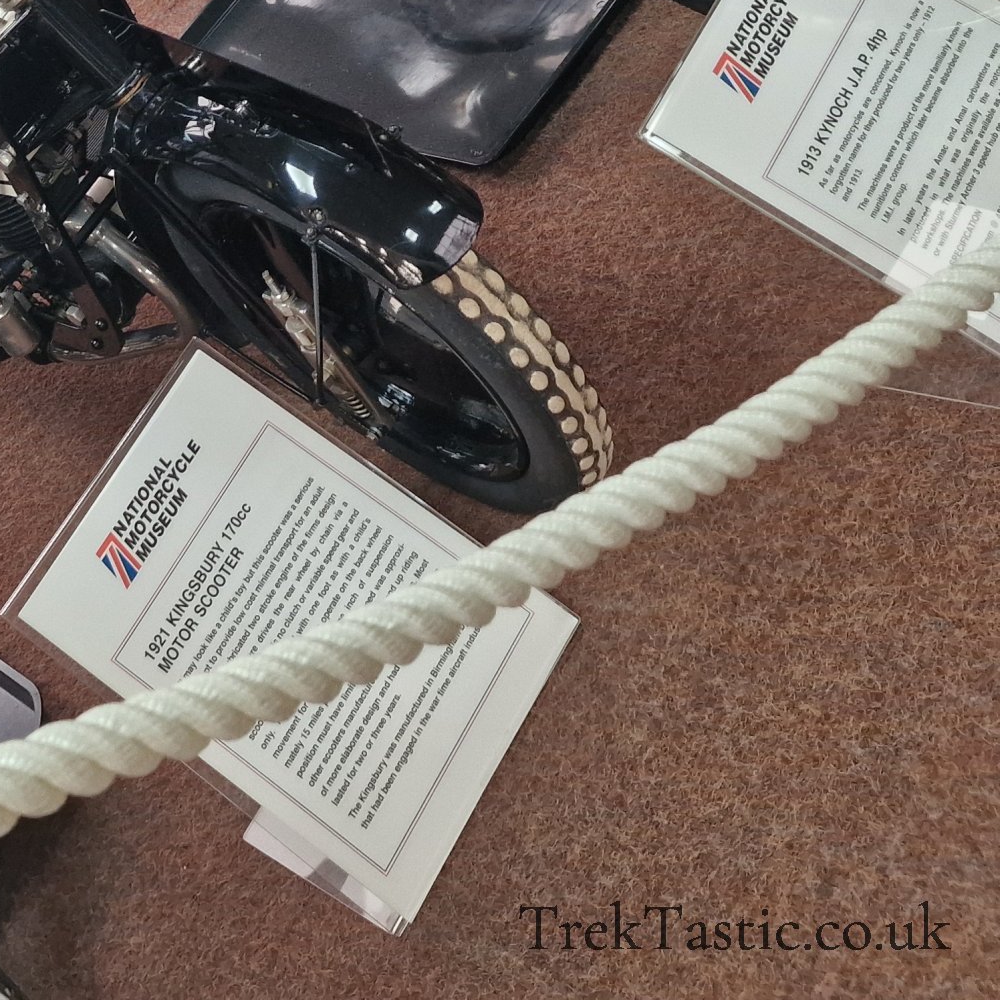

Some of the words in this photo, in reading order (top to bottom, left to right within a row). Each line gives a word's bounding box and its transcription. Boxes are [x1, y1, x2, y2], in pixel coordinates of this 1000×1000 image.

[753, 10, 799, 80] MUSEUM
[797, 145, 822, 176] 1913
[813, 87, 854, 146] KYNOCH
[846, 53, 873, 88] J.A.P.
[866, 28, 888, 52] 4hp
[824, 164, 835, 177] far
[838, 109, 866, 153] motorcycles
[862, 96, 873, 109] are
[869, 58, 895, 96] concerned,
[888, 31, 908, 57] Kynoch
[909, 6, 921, 22] now
[828, 162, 852, 195] forgotten
[847, 142, 863, 163] name
[856, 131, 868, 143] for
[862, 115, 878, 132] they
[872, 82, 894, 118] produced
[888, 72, 899, 85] for
[894, 60, 907, 74] two
[902, 41, 917, 62] years
[912, 26, 926, 42] only
[922, 5, 936, 22] 1912
[856, 197, 870, 212] The
[866, 162, 888, 198] machines
[884, 144, 898, 163] were
[896, 111, 916, 141] product
[913, 91, 926, 104] the
[921, 73, 935, 93] more
[929, 43, 952, 75] familiarly
[869, 182, 893, 220] munitions
[889, 152, 908, 183] concern
[904, 130, 920, 153] which
[914, 113, 928, 131] later
[923, 85, 943, 114] became
[939, 52, 960, 86] absorbed
[955, 39, 967, 54] into
[962, 27, 974, 39] the
[841, 185, 854, 203] and
[848, 168, 864, 186] 1913.
[880, 206, 896, 224] I.M.I.
[891, 183, 908, 207] group.
[112, 457, 173, 539] NATIONAL
[123, 438, 201, 551] MOTORCYCLE
[134, 487, 188, 563] MUSEUM
[304, 518, 321, 539] firms
[318, 492, 337, 519] design
[144, 627, 171, 661] 1921
[165, 540, 225, 628] KINGSBURY
[221, 503, 252, 541] 170cc
[192, 642, 209, 662] look
[204, 628, 218, 645] like
[219, 596, 239, 623] child's
[234, 582, 248, 597] toy
[242, 568, 256, 584] but
[251, 553, 265, 571] this
[262, 524, 283, 555] scooter
[279, 509, 294, 526] was
[294, 476, 315, 505] serious
[208, 655, 218, 666] to
[215, 625, 237, 657] provide
[232, 609, 247, 626] low
[243, 591, 258, 611] cost
[254, 560, 277, 594] minimal
[272, 527, 299, 563] transport
[294, 515, 306, 529] for
[303, 505, 313, 518] an
[309, 486, 326, 507] adult.
[257, 618, 276, 644] drives
[272, 602, 285, 617] the
[283, 583, 296, 602] rear
[295, 558, 313, 583] wheel
[309, 546, 321, 558] by
[318, 523, 335, 545] chain
[332, 509, 344, 521] via
[274, 561, 294, 589] engine
[276, 627, 287, 640] no
[283, 603, 302, 629] clutch
[298, 593, 307, 604] or
[304, 564, 326, 594] variable
[322, 539, 341, 565] speed
[337, 523, 351, 544] gear
[347, 507, 360, 525] and
[291, 551, 300, 562] of
[295, 538, 308, 553] the
[295, 617, 310, 635] with
[308, 599, 321, 616] one
[317, 581, 332, 599] foot
[329, 569, 339, 582] as
[336, 551, 351, 569] with
[353, 517, 372, 543] child's
[320, 593, 342, 624] operate
[339, 581, 349, 594] on
[344, 568, 357, 582] the
[352, 548, 369, 569] back
[366, 524, 383, 549] wheel
[343, 592, 360, 611] inch
[358, 578, 366, 590] of
[365, 534, 395, 578] suspension
[373, 574, 387, 591] was
[384, 543, 405, 575] approxi-
[394, 573, 405, 586] up
[400, 550, 419, 574] riding
[413, 558, 430, 580] Most
[157, 617, 199, 674] MOTOR
[193, 546, 245, 618] SCOOTER
[247, 614, 261, 631] two
[258, 588, 277, 615] stroke
[260, 730, 276, 750] only.
[272, 715, 302, 760] movement
[297, 701, 309, 716] for
[284, 739, 305, 769] mately
[300, 727, 311, 740] 15
[307, 705, 325, 730] miles
[296, 743, 320, 780] position
[316, 721, 333, 744] must
[328, 701, 345, 722] have
[308, 763, 325, 788] other
[321, 727, 346, 765] scooters
[320, 784, 330, 797] of
[326, 763, 343, 787] more
[339, 725, 365, 765] elaborate
[362, 697, 382, 726] design
[378, 679, 391, 699] and
[386, 664, 401, 682] had
[330, 778, 351, 807] lasted
[346, 765, 358, 781] for
[354, 749, 368, 767] two
[365, 738, 374, 751] or
[370, 717, 387, 740] three
[384, 694, 402, 719] years.
[347, 801, 363, 819] The
[357, 758, 388, 804] Kingsbury
[383, 741, 398, 760] was
[394, 684, 429, 743] manufactured
[424, 677, 435, 688] in
[360, 810, 376, 830] that
[370, 792, 385, 813] had
[380, 772, 398, 795] been
[394, 734, 418, 773] engaged
[413, 726, 424, 737] in
[419, 712, 432, 727] the
[428, 695, 441, 713] war
[436, 677, 452, 697] time
[448, 648, 468, 679] aircraft
